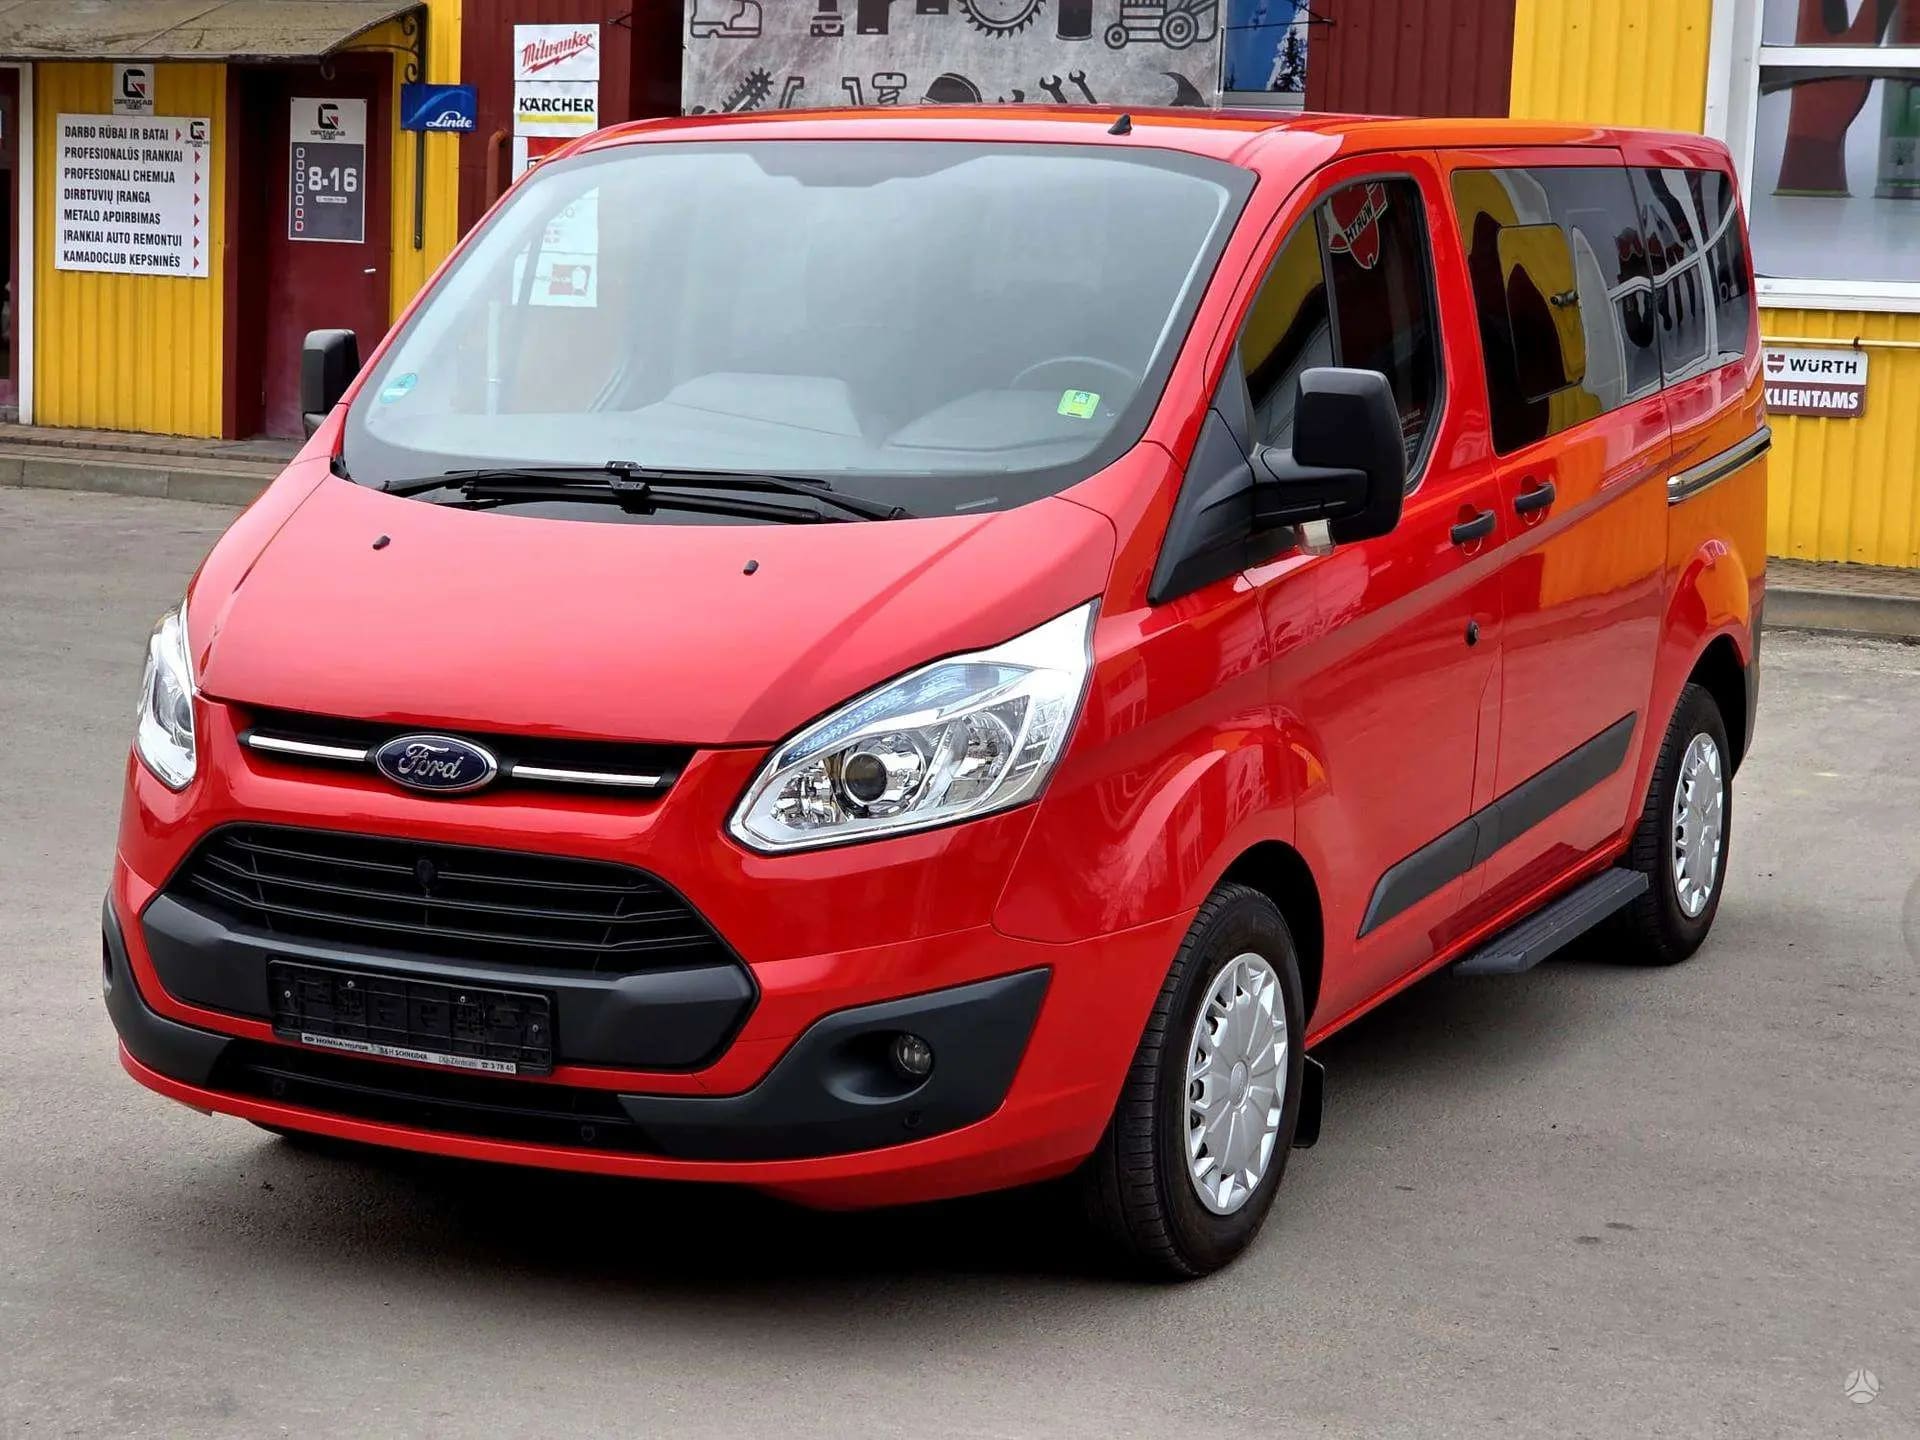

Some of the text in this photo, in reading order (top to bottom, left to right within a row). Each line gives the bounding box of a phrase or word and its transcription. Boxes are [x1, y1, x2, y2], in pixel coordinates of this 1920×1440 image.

[519, 97, 594, 112] KÄRCHER
[426, 110, 473, 128] Linde
[65, 125, 169, 141] DARBO RŪBAI IR BATAI
[142, 149, 183, 164] ĮRANKIAI
[64, 167, 175, 183] PROFESIONALI CHEMIJA
[64, 188, 151, 205] DIRBTUVIŲ ĮRANGA
[64, 209, 161, 225] METALO APDIRBIMAS
[64, 229, 182, 247] ĮRANKIAI AUTO REMONTUI
[64, 250, 126, 265] KAMADOCLUB
[398, 743, 465, 779] Ford
